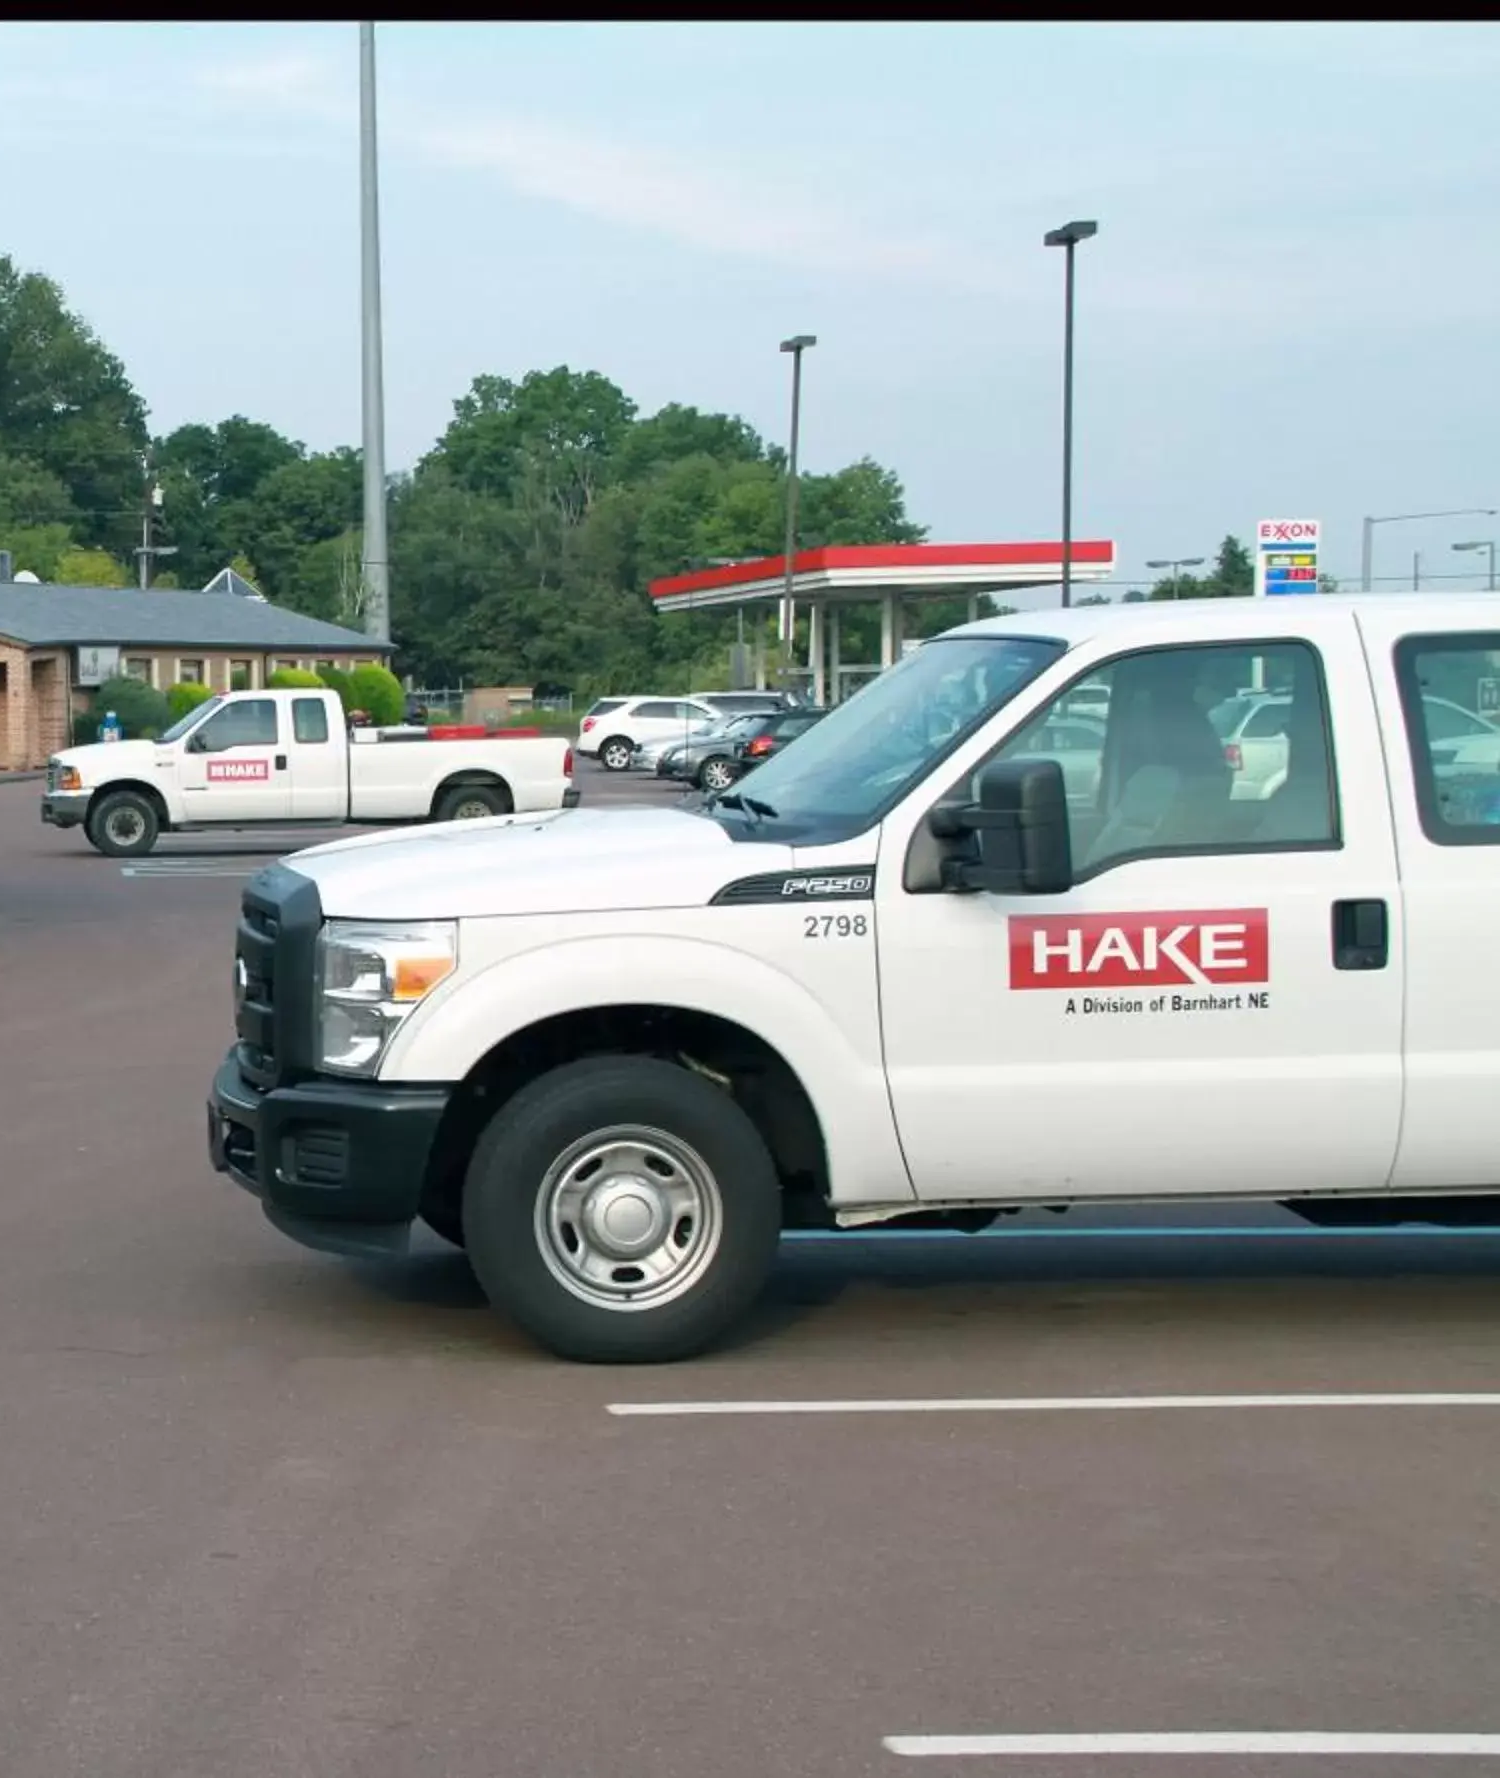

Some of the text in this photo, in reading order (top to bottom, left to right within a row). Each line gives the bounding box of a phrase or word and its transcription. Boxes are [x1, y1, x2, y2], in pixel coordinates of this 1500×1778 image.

[1261, 523, 1316, 540] EXXON
[804, 914, 867, 938] 2798
[1033, 924, 1248, 984] HAKE
[1065, 992, 1269, 1014] A Division of Barnhart NE
